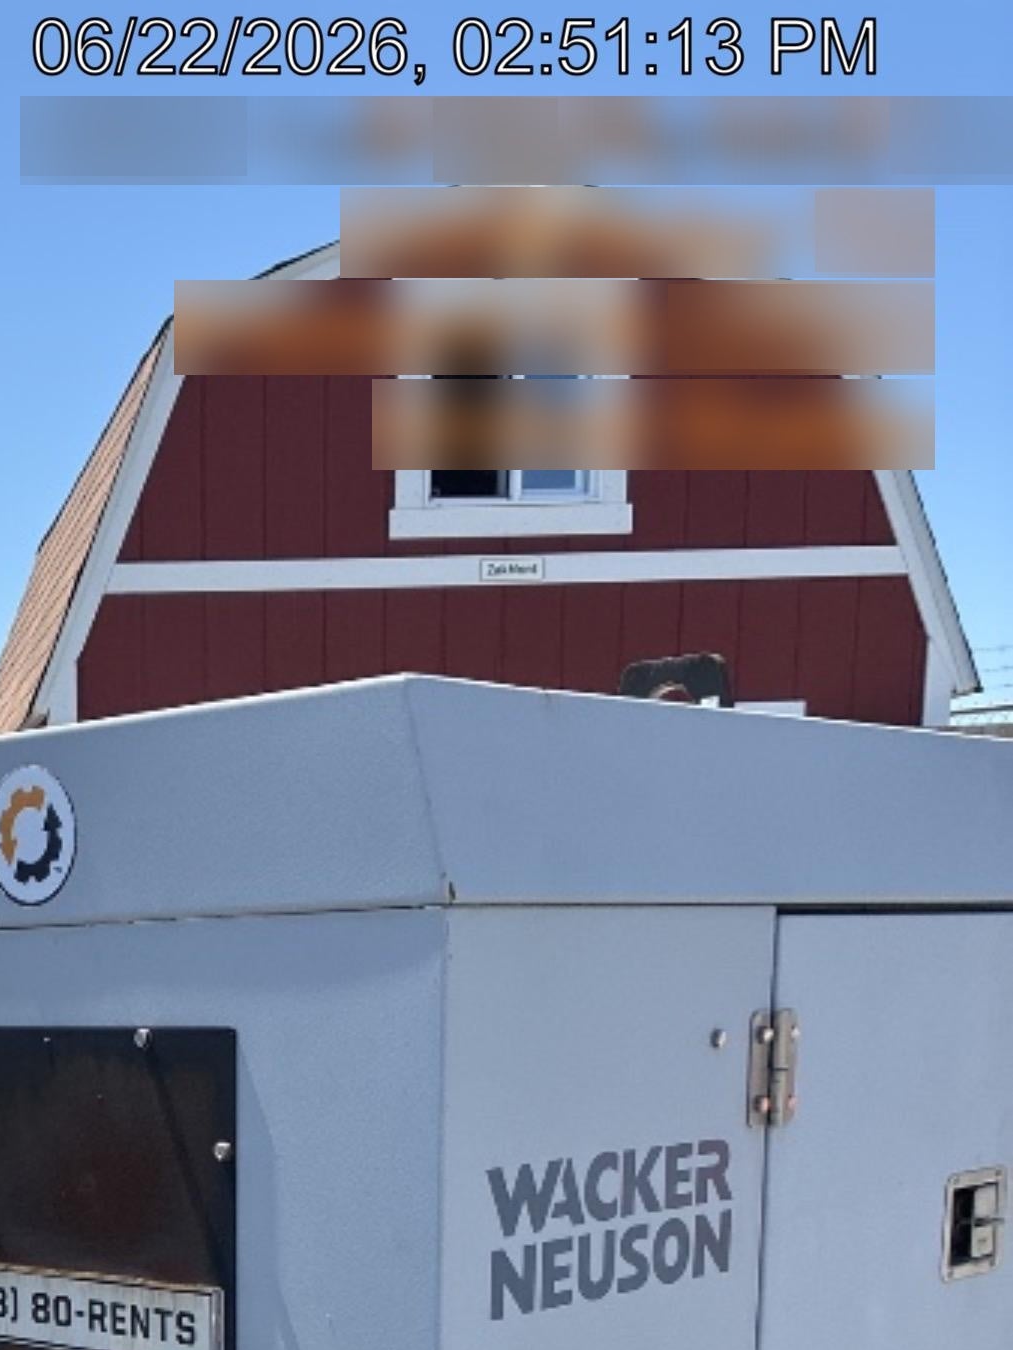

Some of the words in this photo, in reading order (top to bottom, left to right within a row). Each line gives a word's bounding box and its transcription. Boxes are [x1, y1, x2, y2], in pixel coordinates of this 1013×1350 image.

[485, 1139, 733, 1238] WACKER
[490, 1209, 733, 1321] NEUSON
[31, 1291, 196, 1346] 80-RENTS
